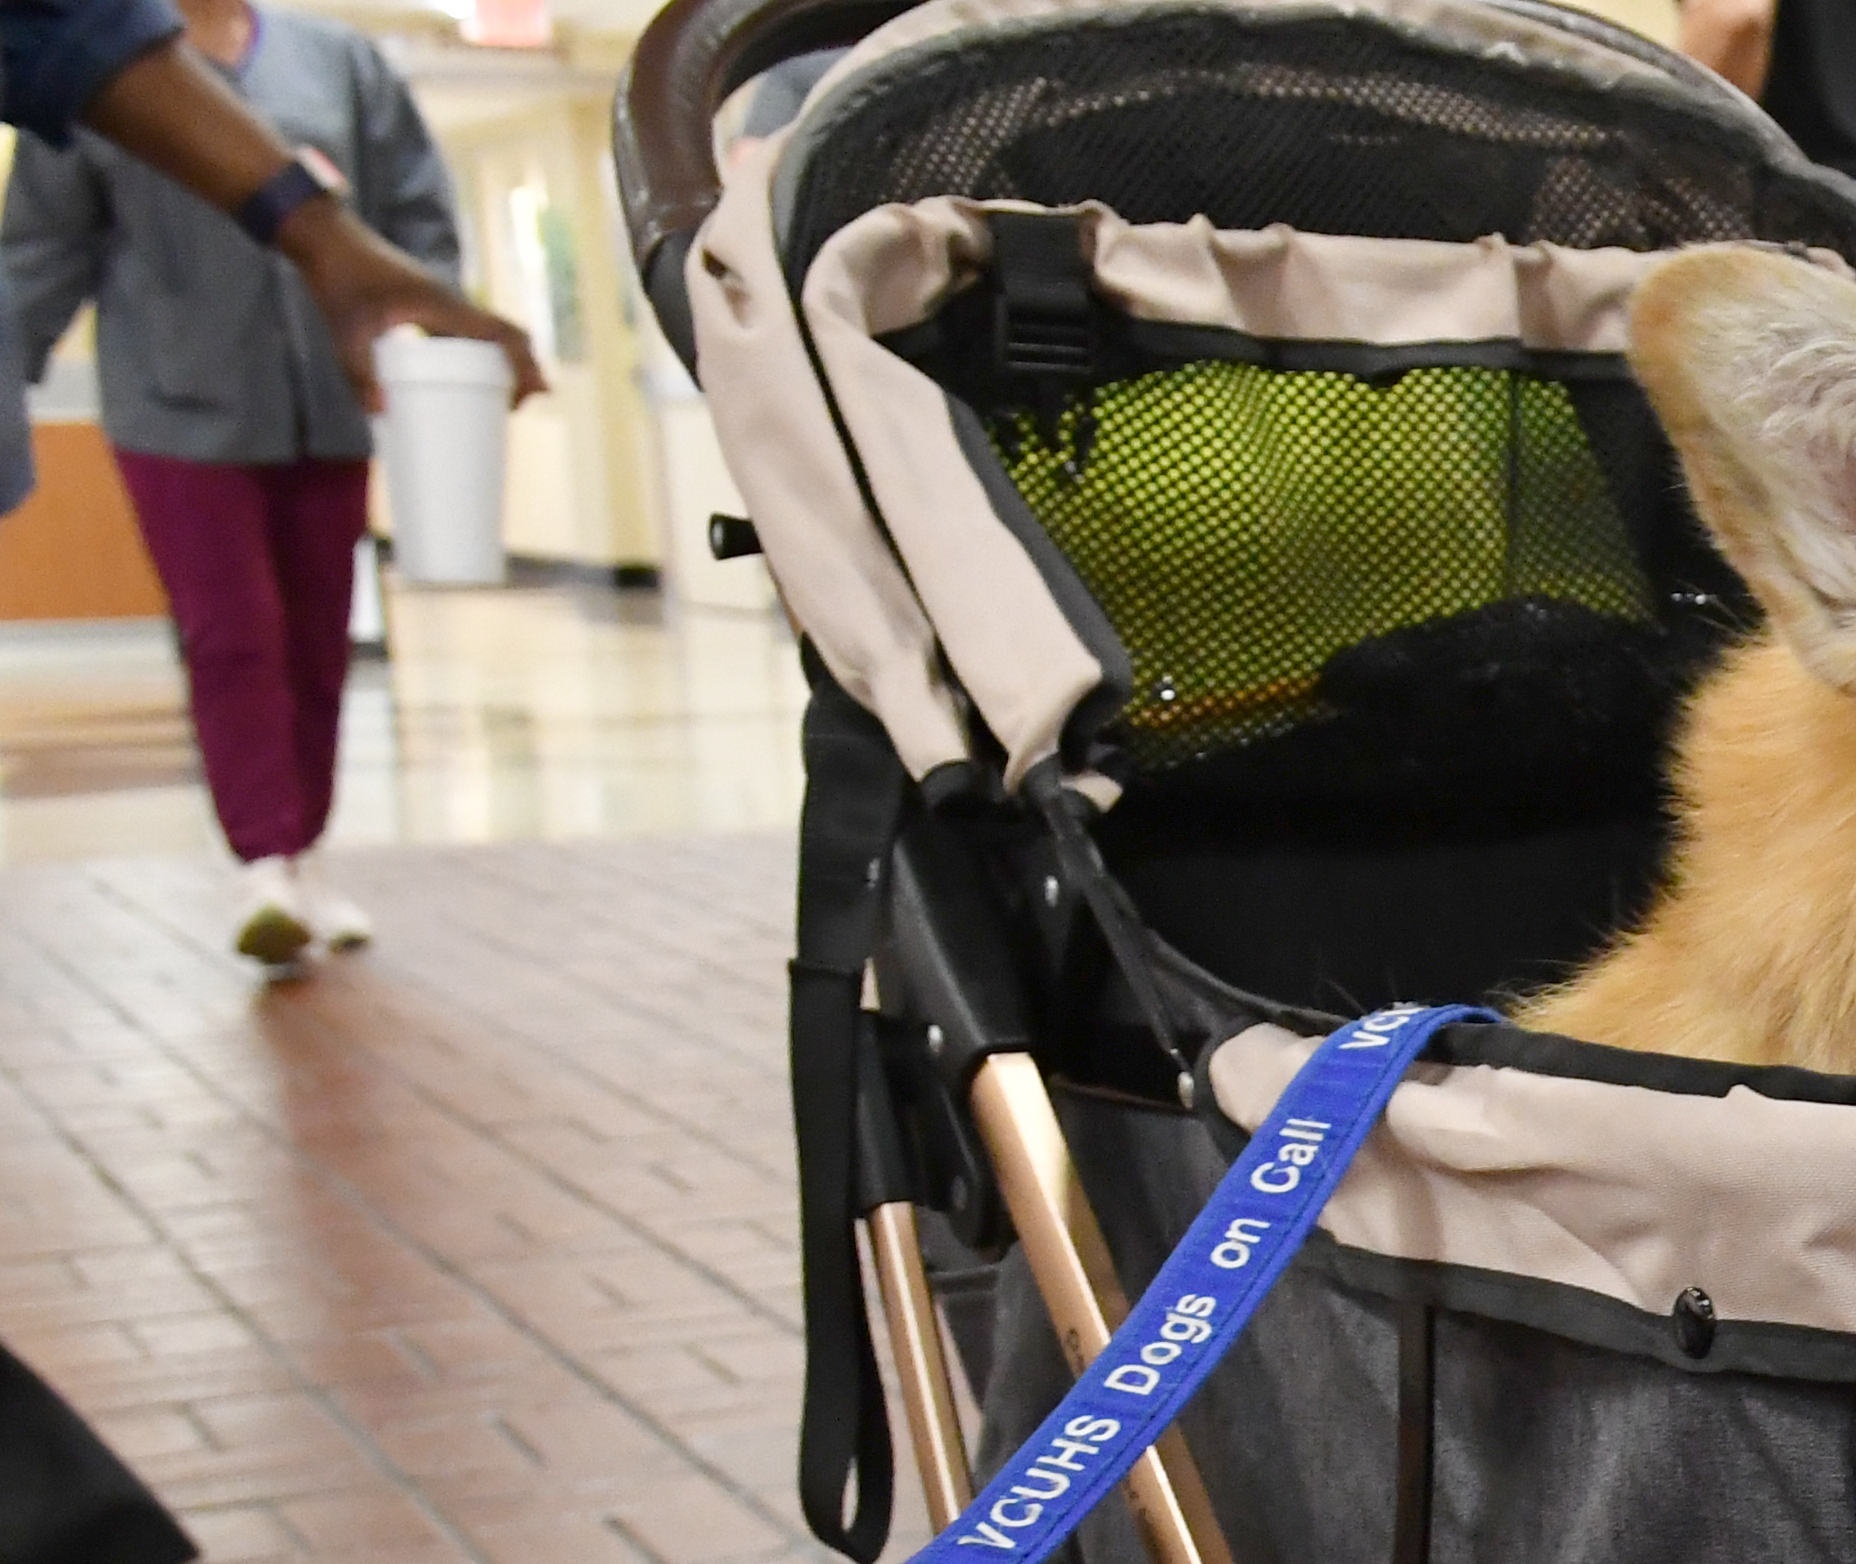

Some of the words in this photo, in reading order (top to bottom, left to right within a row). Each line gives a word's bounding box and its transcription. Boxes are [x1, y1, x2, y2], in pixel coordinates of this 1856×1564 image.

[957, 1414, 1121, 1551] VCUHS
[1104, 1294, 1217, 1396] Dogs
[1209, 1217, 1271, 1270] on
[1250, 1118, 1332, 1194] Call
